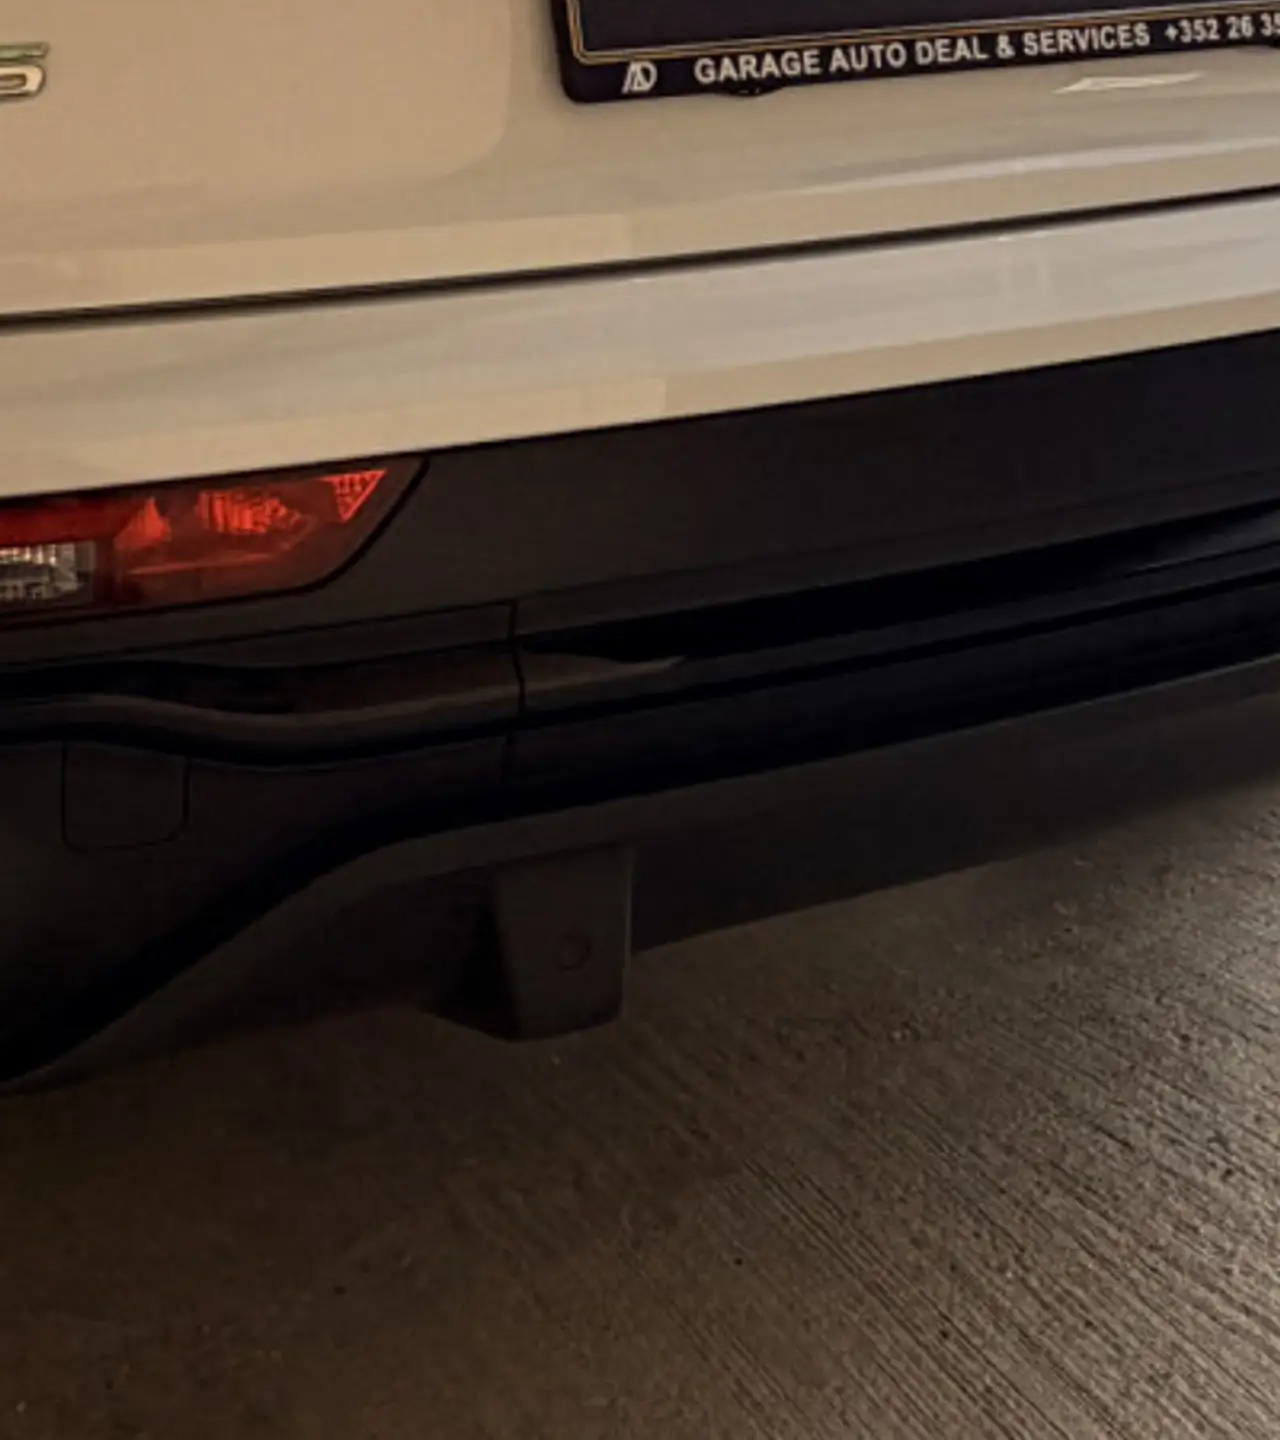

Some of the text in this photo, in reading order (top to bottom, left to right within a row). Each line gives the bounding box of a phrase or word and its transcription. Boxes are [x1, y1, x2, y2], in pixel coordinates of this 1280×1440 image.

[693, 49, 821, 84] GARAGE
[829, 41, 907, 73] AUTO
[915, 36, 989, 67] DEAL
[996, 34, 1015, 59] &
[1023, 22, 1151, 57] SERVICES
[1164, 16, 1220, 44] +352
[1226, 14, 1254, 39] 26
